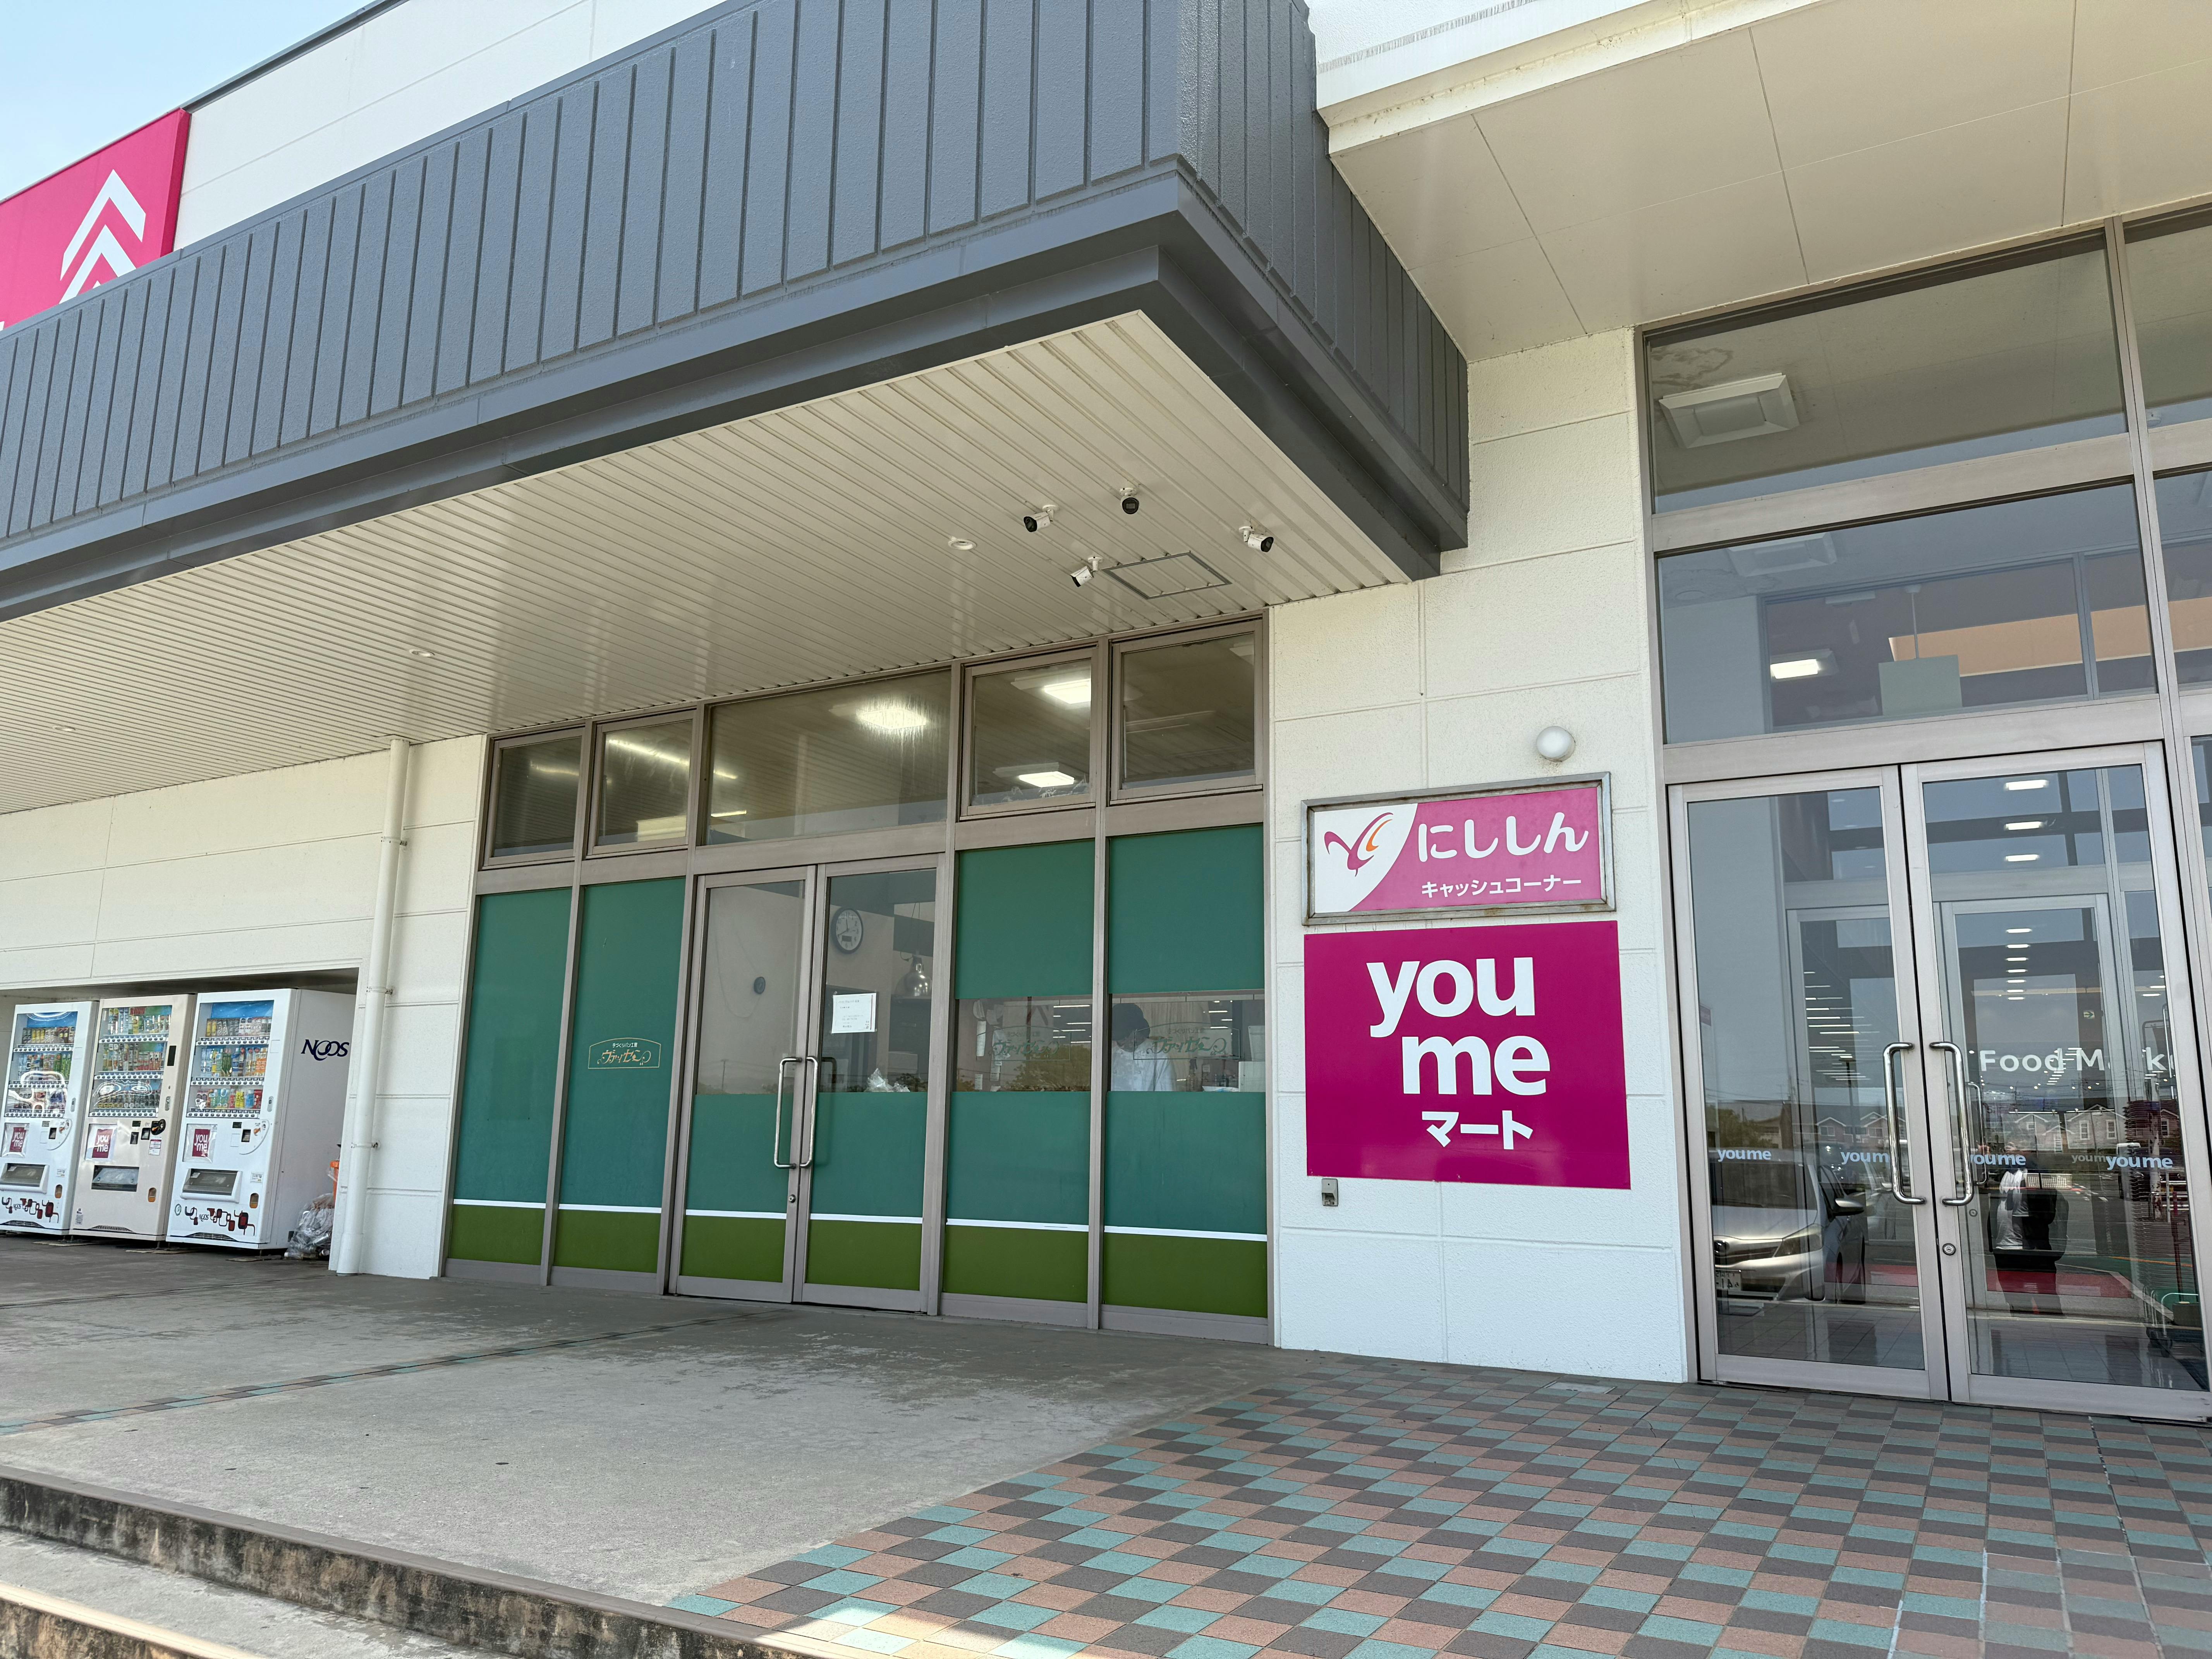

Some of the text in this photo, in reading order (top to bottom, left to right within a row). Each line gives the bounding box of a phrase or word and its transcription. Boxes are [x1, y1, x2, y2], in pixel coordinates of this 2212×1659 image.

[1419, 812, 1589, 862] にししん
[1421, 874, 1582, 898] キャッシュコーナー
[1366, 957, 1535, 1037] you
[1402, 1035, 1550, 1095] me
[1980, 1048, 2064, 1072] Food
[1422, 1110, 1533, 1150] マート
[12, 1132, 24, 1142] you
[14, 1139, 23, 1148] me
[96, 1135, 109, 1145] you
[194, 1134, 208, 1146] you
[97, 1144, 108, 1152] me
[1841, 1151, 1889, 1164] youm
[2071, 1154, 2106, 1163] youm
